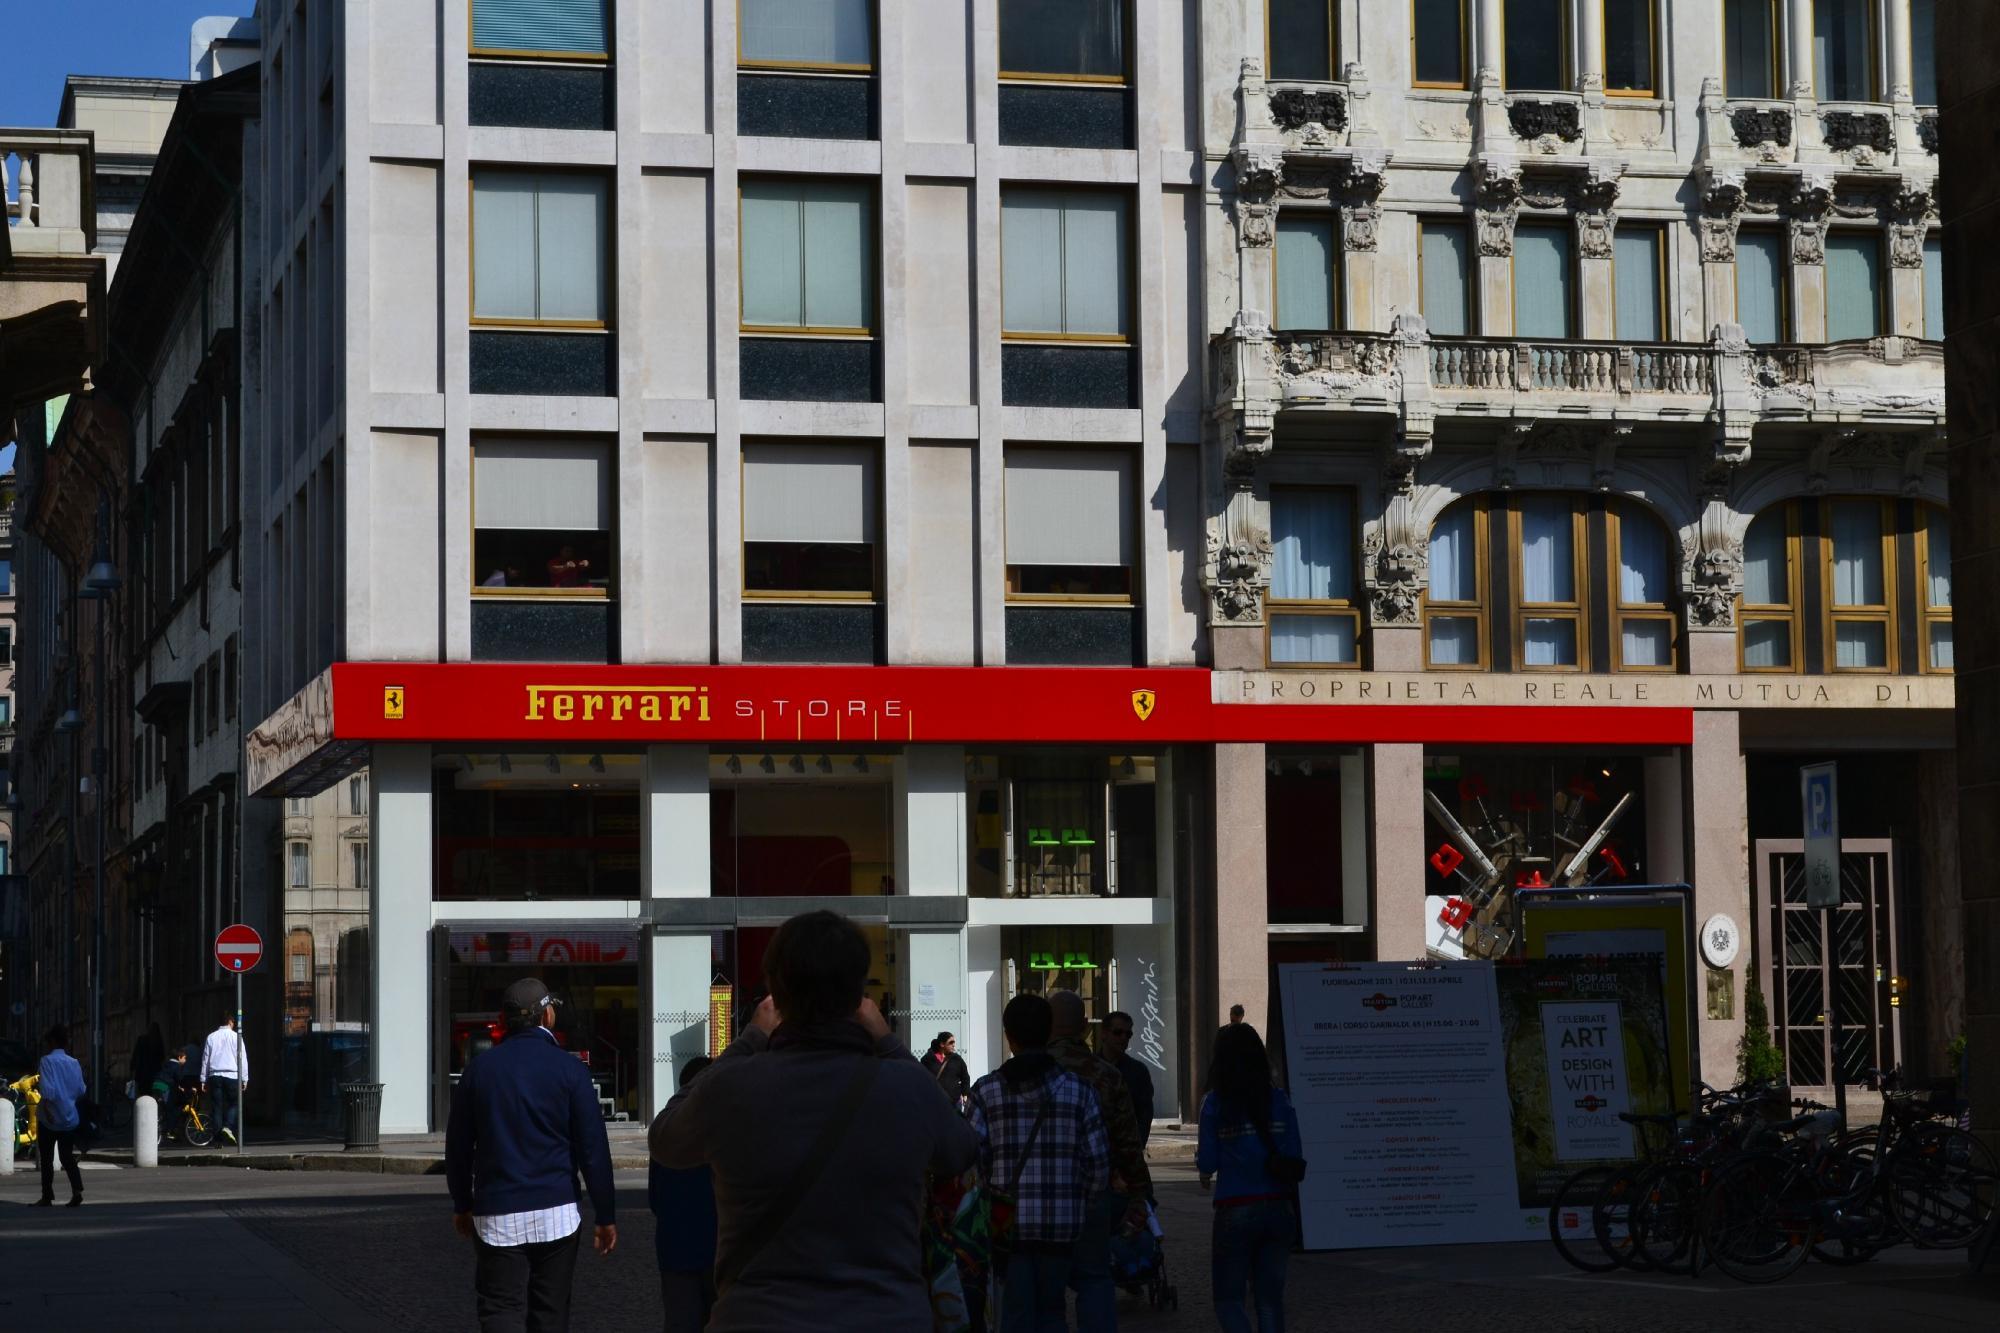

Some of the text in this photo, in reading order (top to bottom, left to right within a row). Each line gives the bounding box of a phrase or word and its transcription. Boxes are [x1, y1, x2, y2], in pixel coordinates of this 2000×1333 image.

[1525, 682, 1648, 700] REALE
[1696, 683, 1830, 700] MUTUA
[1876, 685, 1911, 701] DI
[525, 685, 902, 721] Ferrari STORE
[1811, 783, 1826, 831] P
[1556, 1014, 1607, 1024] CELEBRATE
[1560, 1026, 1608, 1048] ART
[1561, 1058, 1613, 1071] DESIGN
[1563, 1074, 1615, 1092] WITH
[1567, 1112, 1619, 1129] ROYALE
